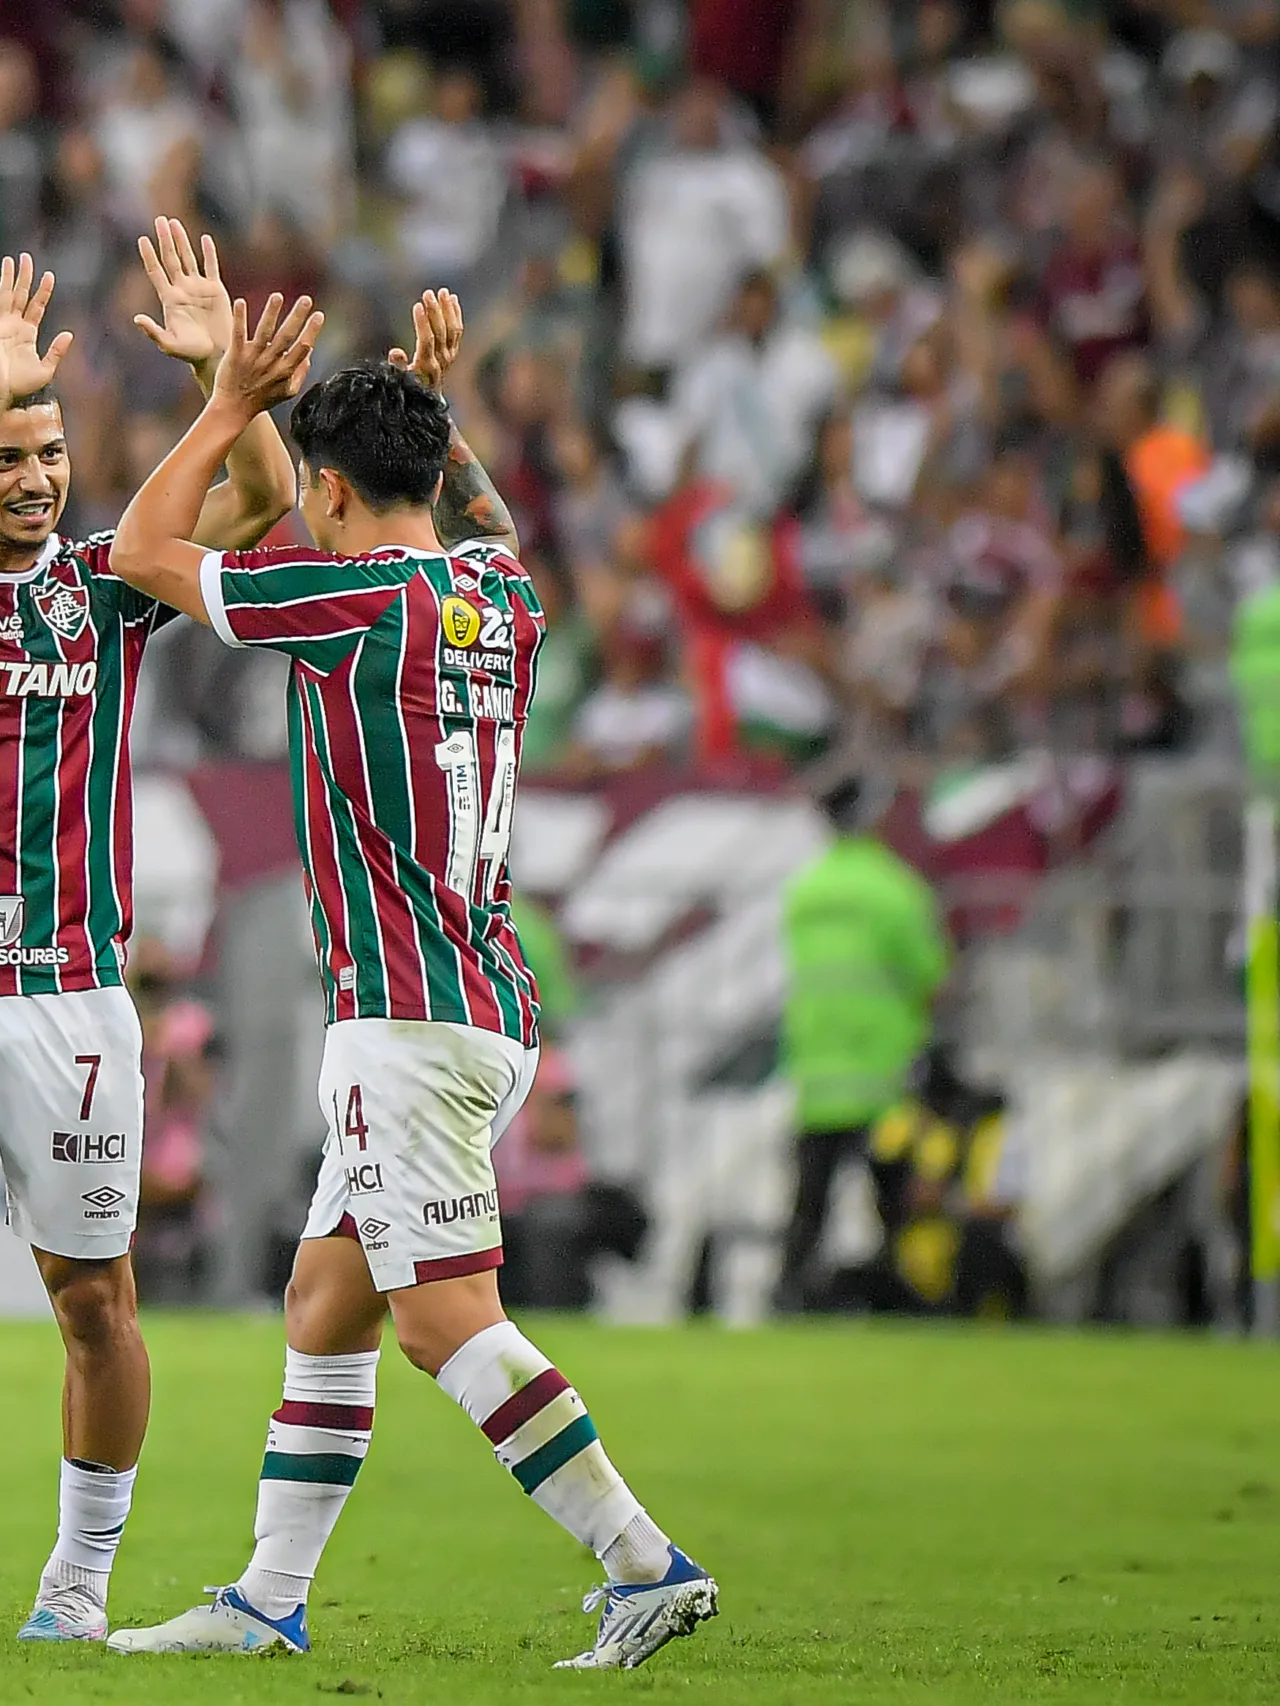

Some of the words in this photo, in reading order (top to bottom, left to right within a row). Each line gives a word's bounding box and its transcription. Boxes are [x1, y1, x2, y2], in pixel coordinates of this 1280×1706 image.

[443, 648, 511, 671] DELIVERY
[441, 680, 464, 713] G.
[471, 683, 512, 721] CANO
[456, 764, 469, 793] TIM
[434, 728, 516, 904] 14
[74, 1053, 101, 1121] 7
[84, 1134, 125, 1160] HCI
[348, 1163, 383, 1192] HCI
[83, 1210, 120, 1220] umbro
